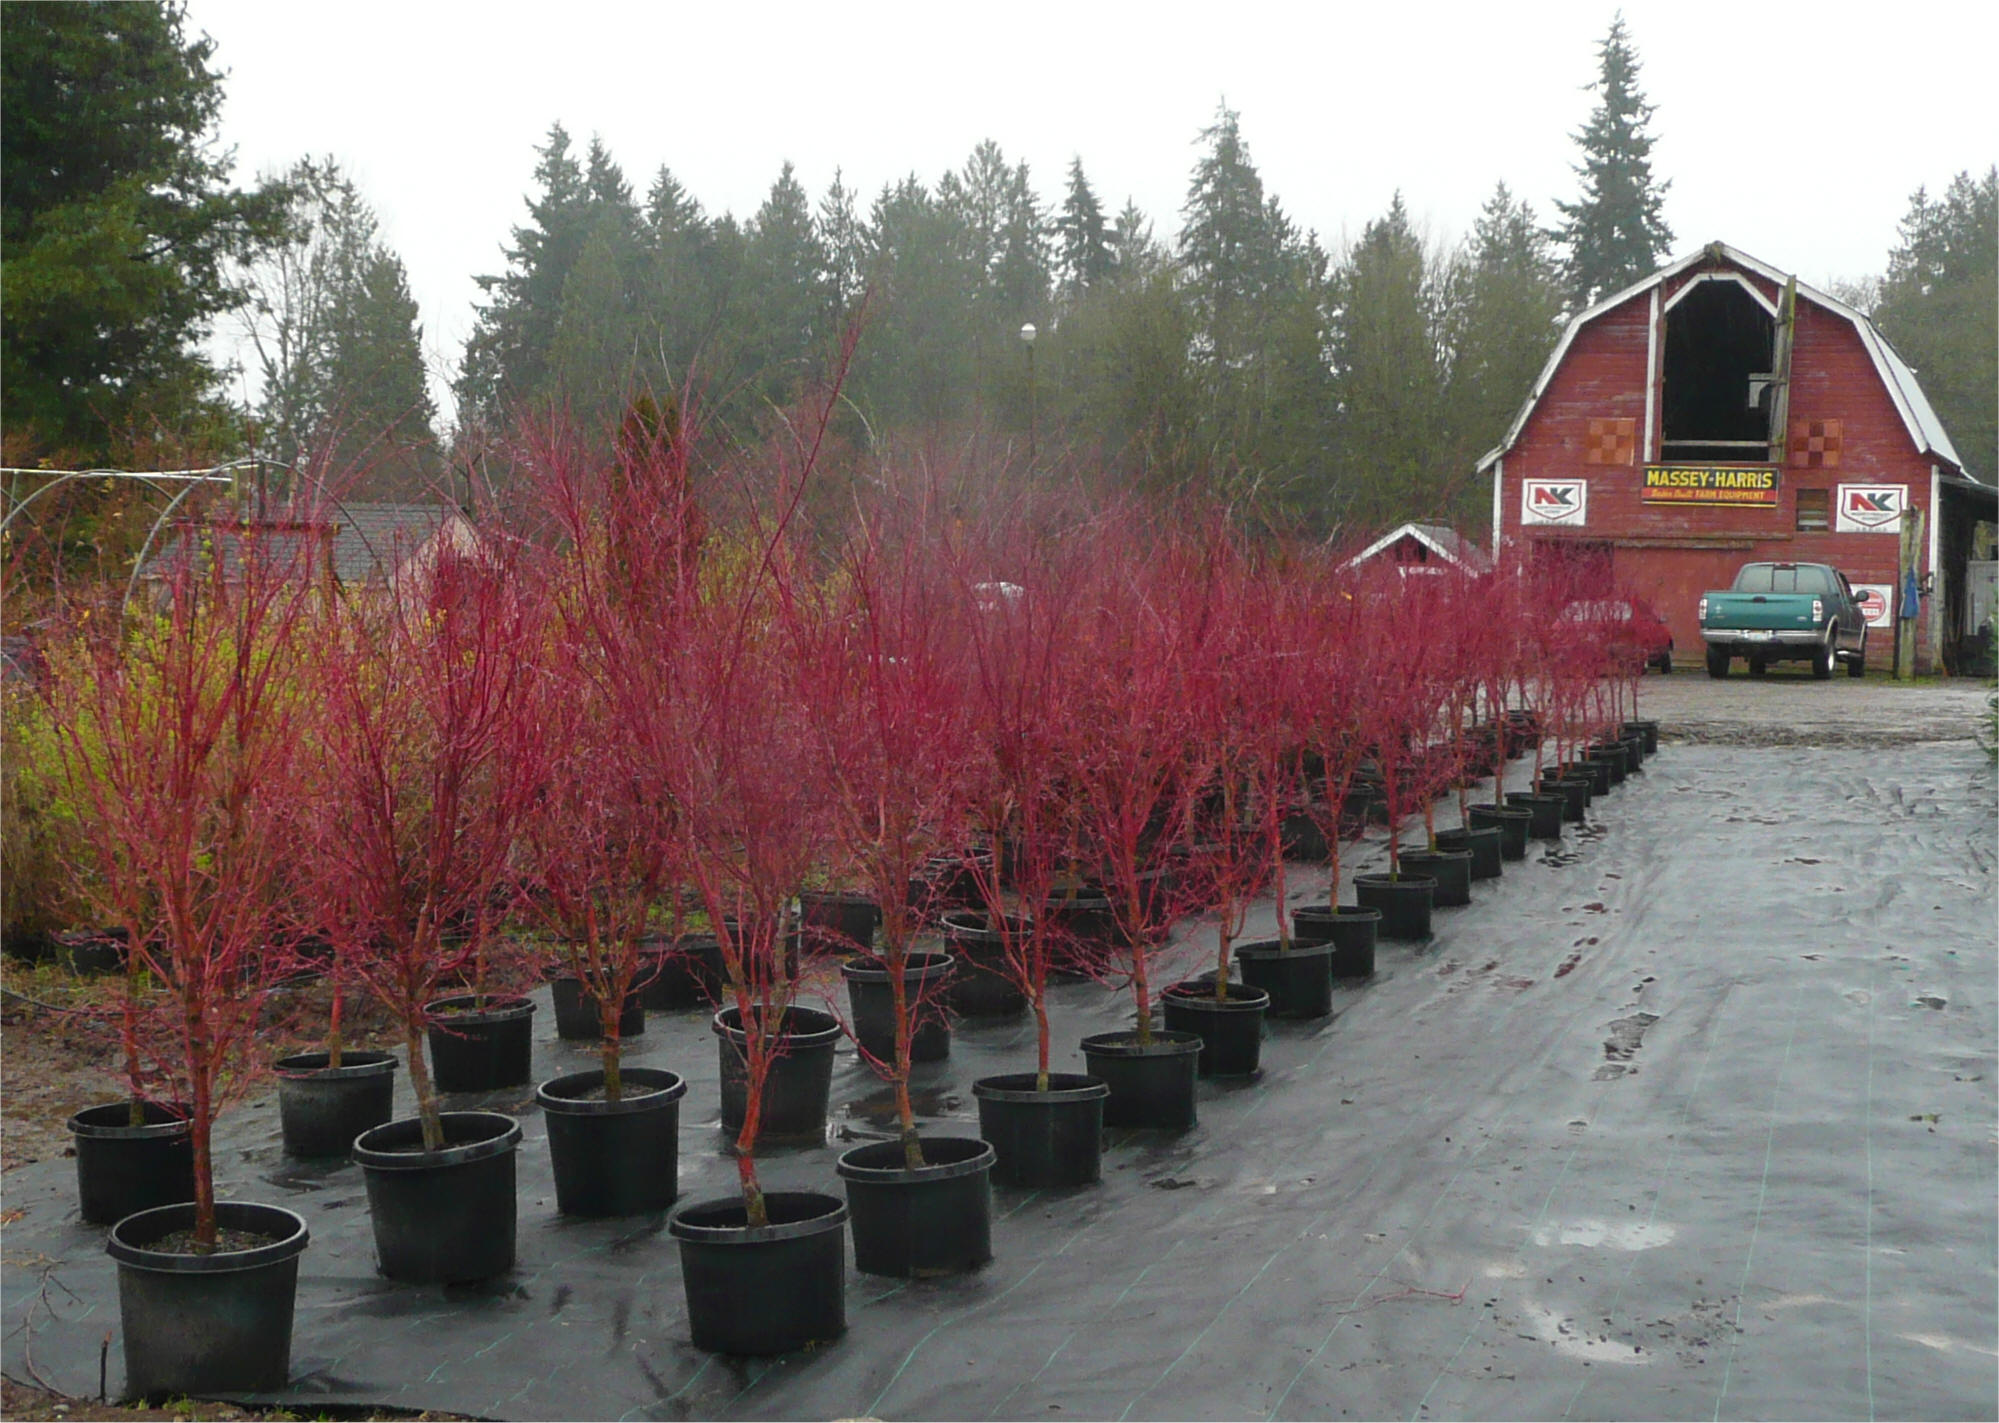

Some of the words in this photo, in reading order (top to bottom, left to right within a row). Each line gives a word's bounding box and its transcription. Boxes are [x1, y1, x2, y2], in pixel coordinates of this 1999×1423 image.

[1647, 470, 1773, 488] MASSEY-HARRIS
[1535, 487, 1574, 505] NK
[1719, 490, 1765, 501] EQUIPMENT
[1850, 493, 1895, 511] NK
